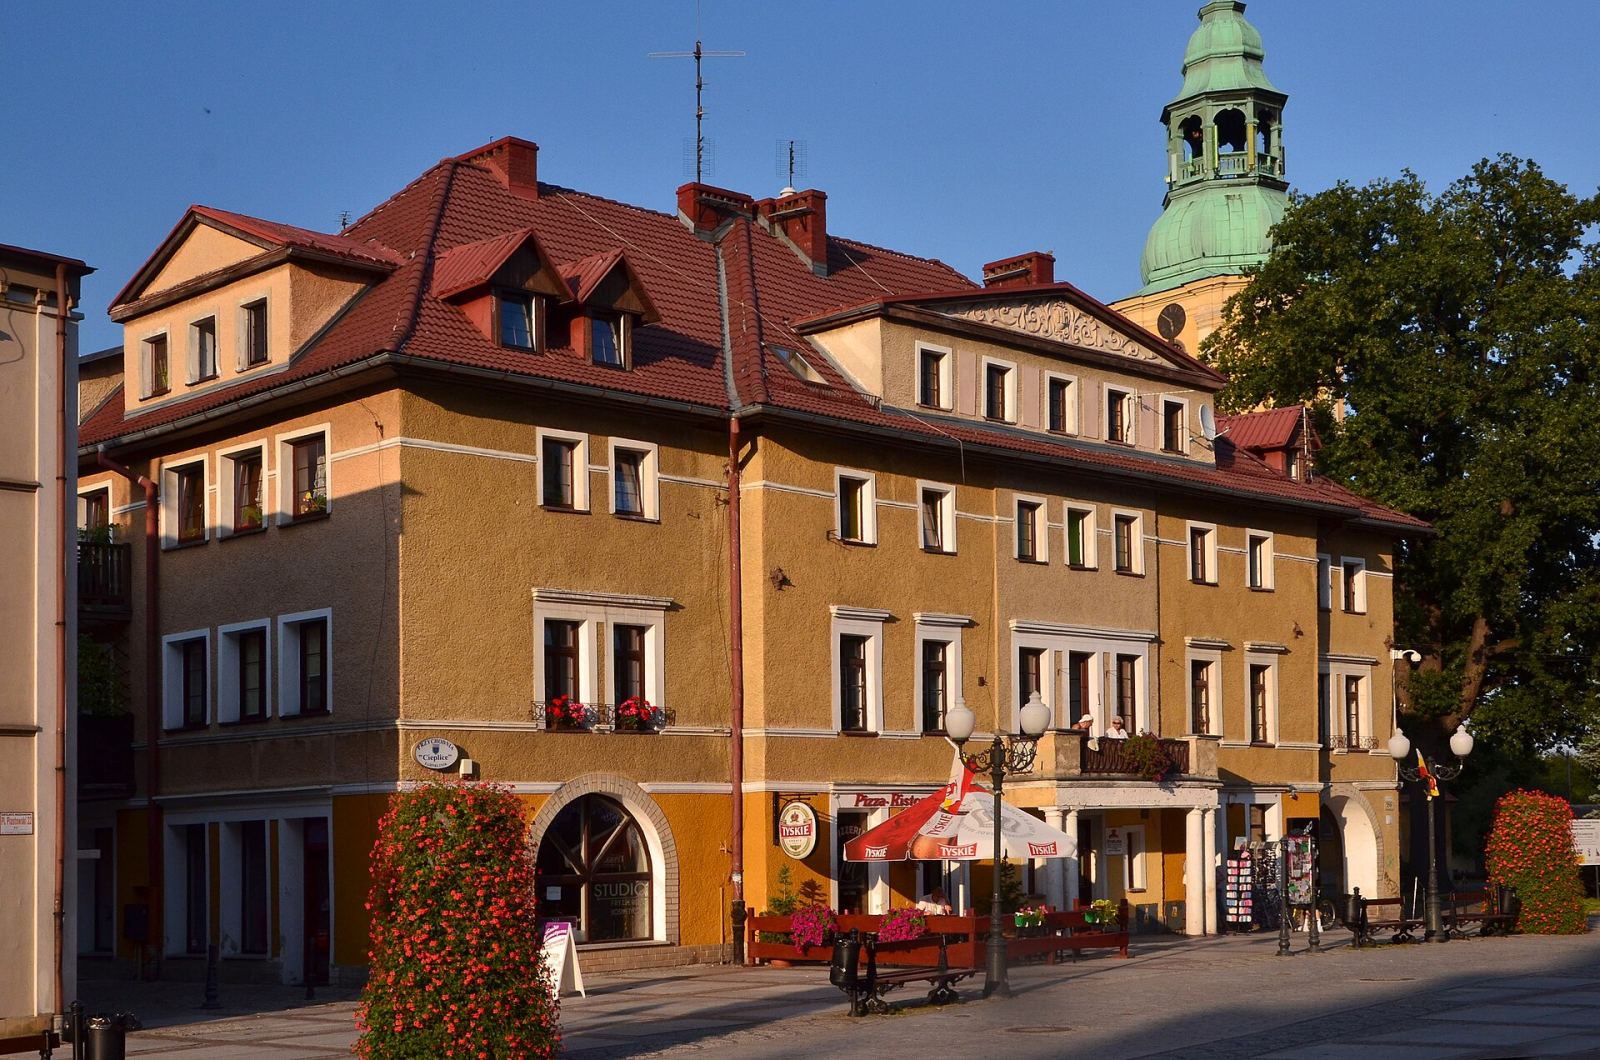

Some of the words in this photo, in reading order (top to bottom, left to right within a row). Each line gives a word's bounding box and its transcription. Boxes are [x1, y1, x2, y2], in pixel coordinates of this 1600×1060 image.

[781, 824, 810, 836] TYSKIE
[927, 813, 953, 836] TYSKIE
[865, 847, 887, 858] TYSKIE
[940, 844, 976, 856] TYSKIE
[1030, 844, 1056, 855] TYSKIE
[594, 882, 645, 897] STUDIO
